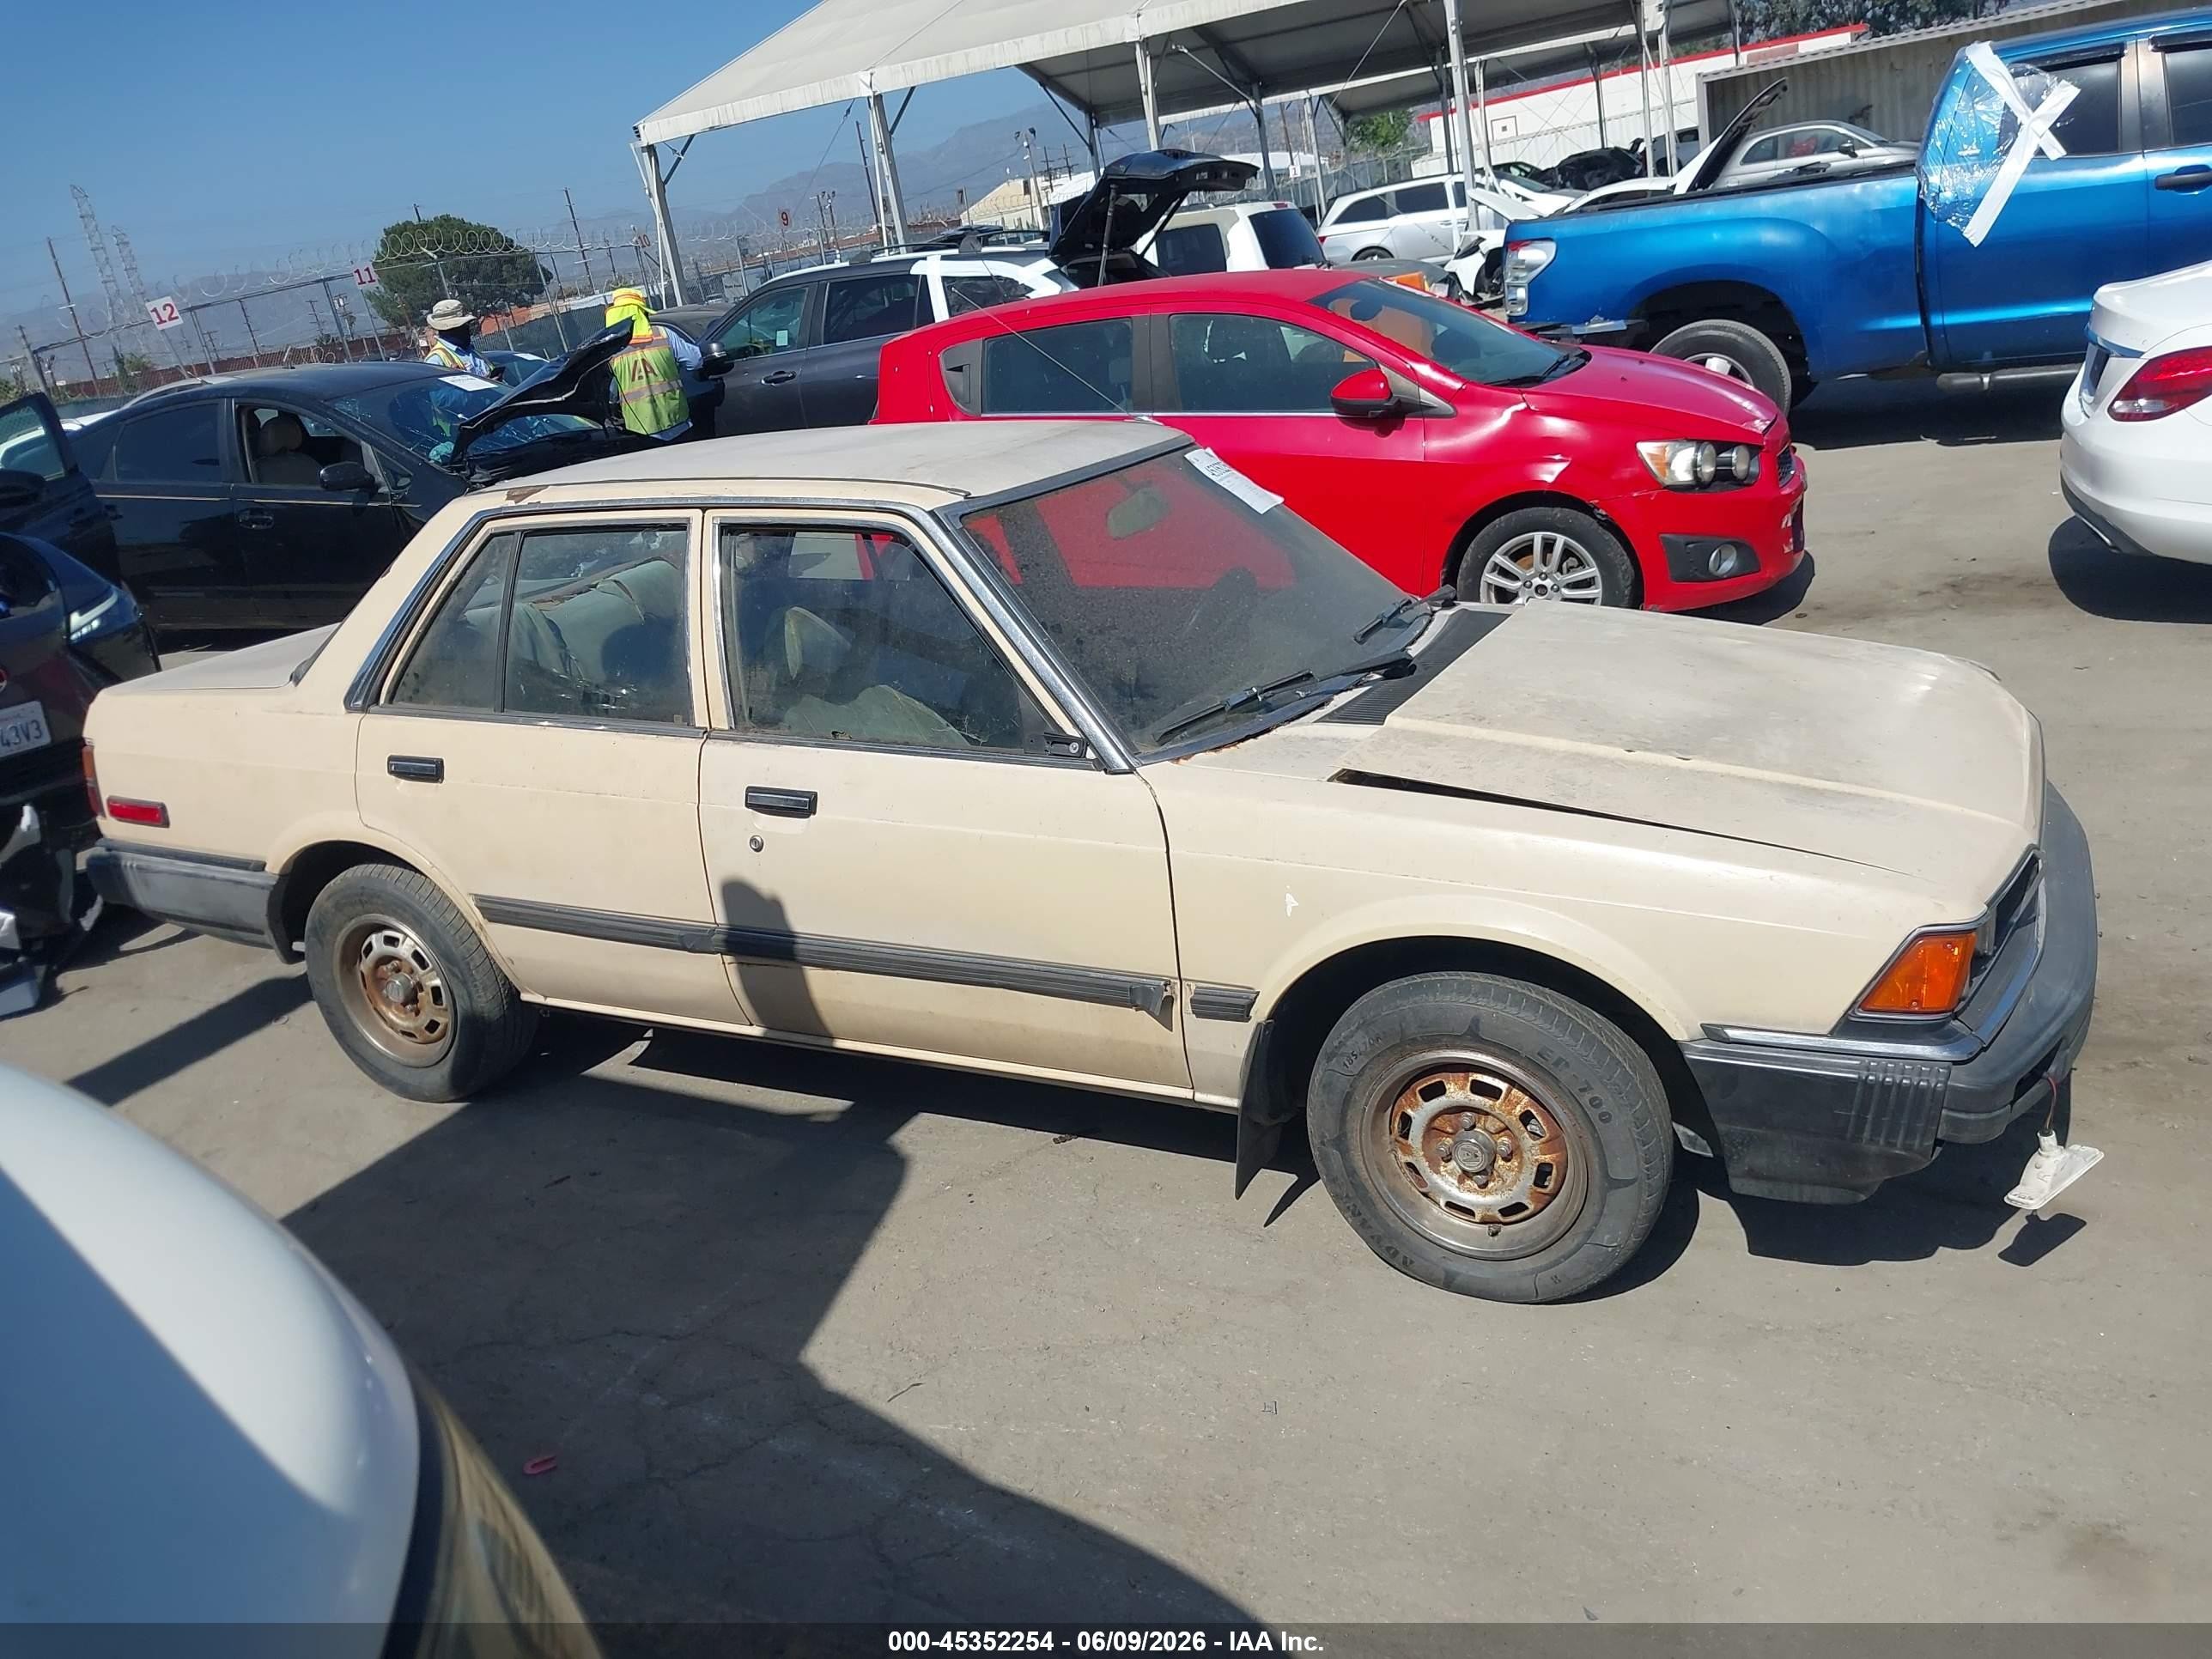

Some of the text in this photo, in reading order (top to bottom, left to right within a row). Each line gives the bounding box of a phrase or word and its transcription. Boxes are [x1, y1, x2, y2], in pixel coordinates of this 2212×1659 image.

[781, 211, 789, 226] 9
[638, 234, 651, 248] 10
[354, 265, 376, 286] 11
[150, 302, 179, 325] 12
